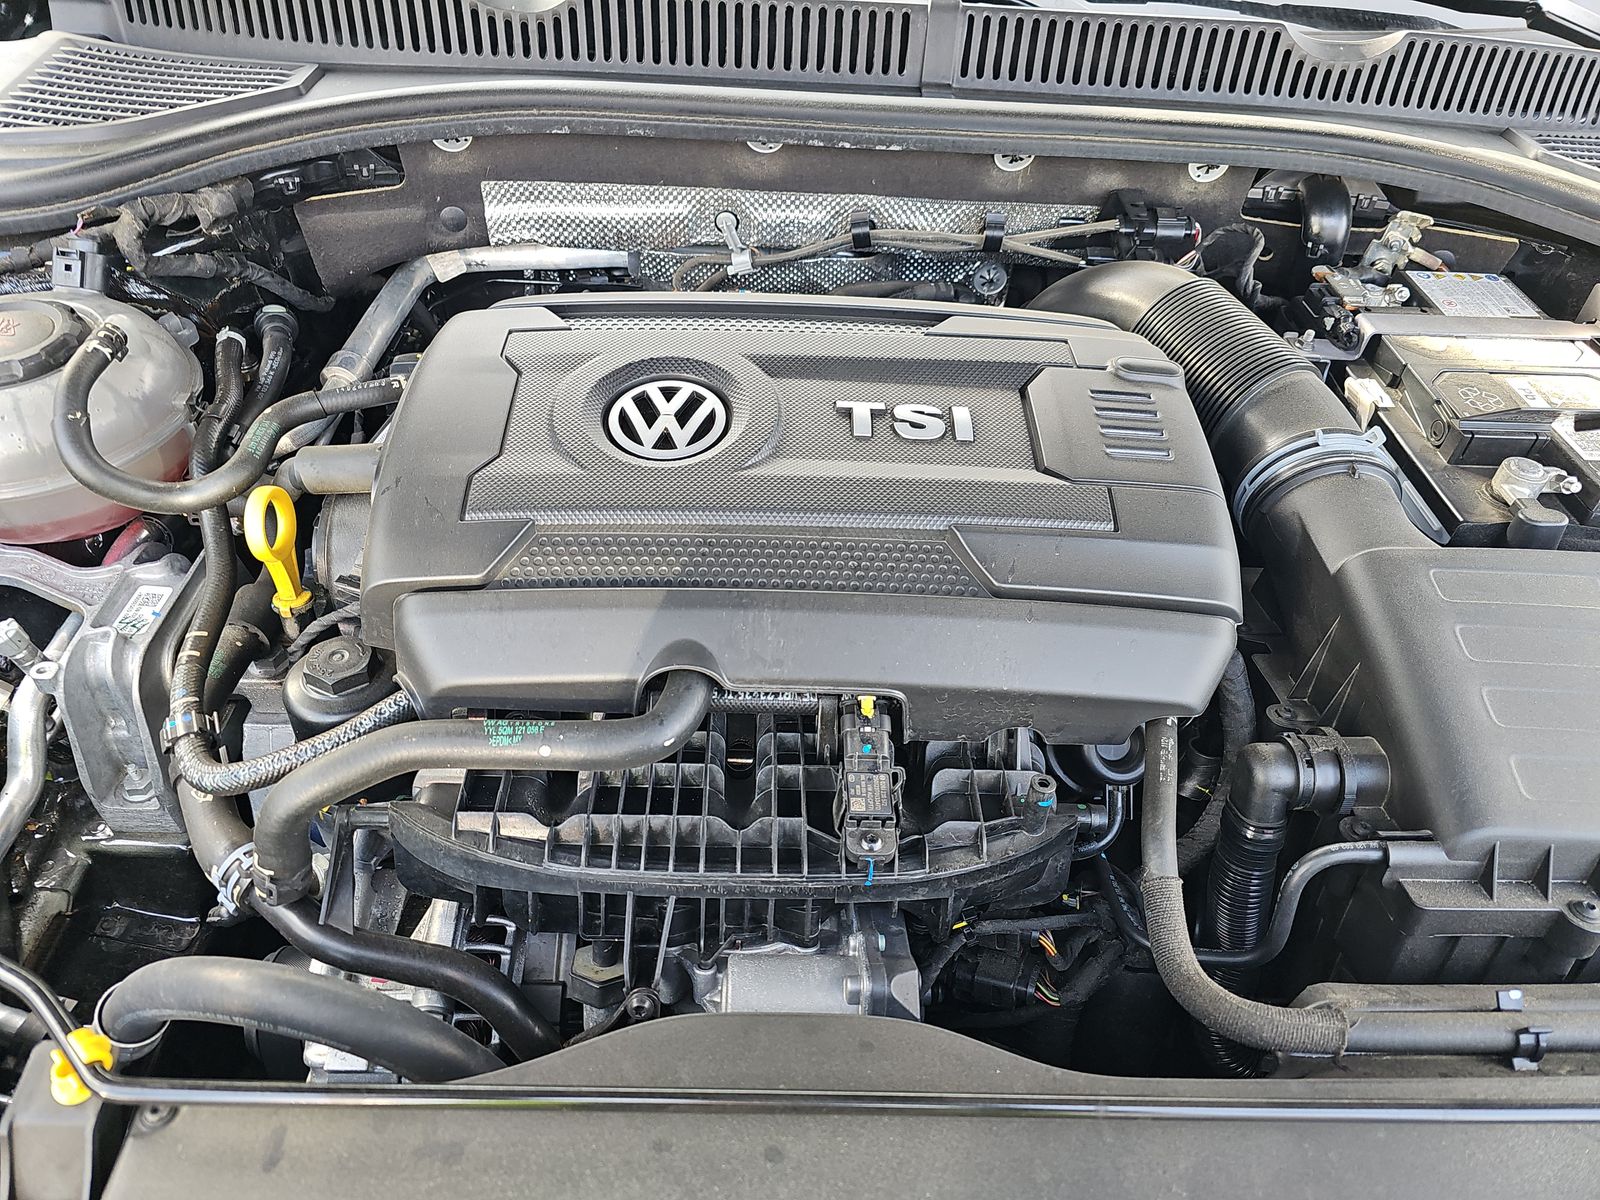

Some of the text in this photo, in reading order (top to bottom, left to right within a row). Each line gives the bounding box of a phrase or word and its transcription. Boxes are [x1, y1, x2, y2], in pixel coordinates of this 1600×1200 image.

[608, 379, 728, 460] VW
[834, 400, 974, 443] TSI
[515, 726, 525, 734] 121
